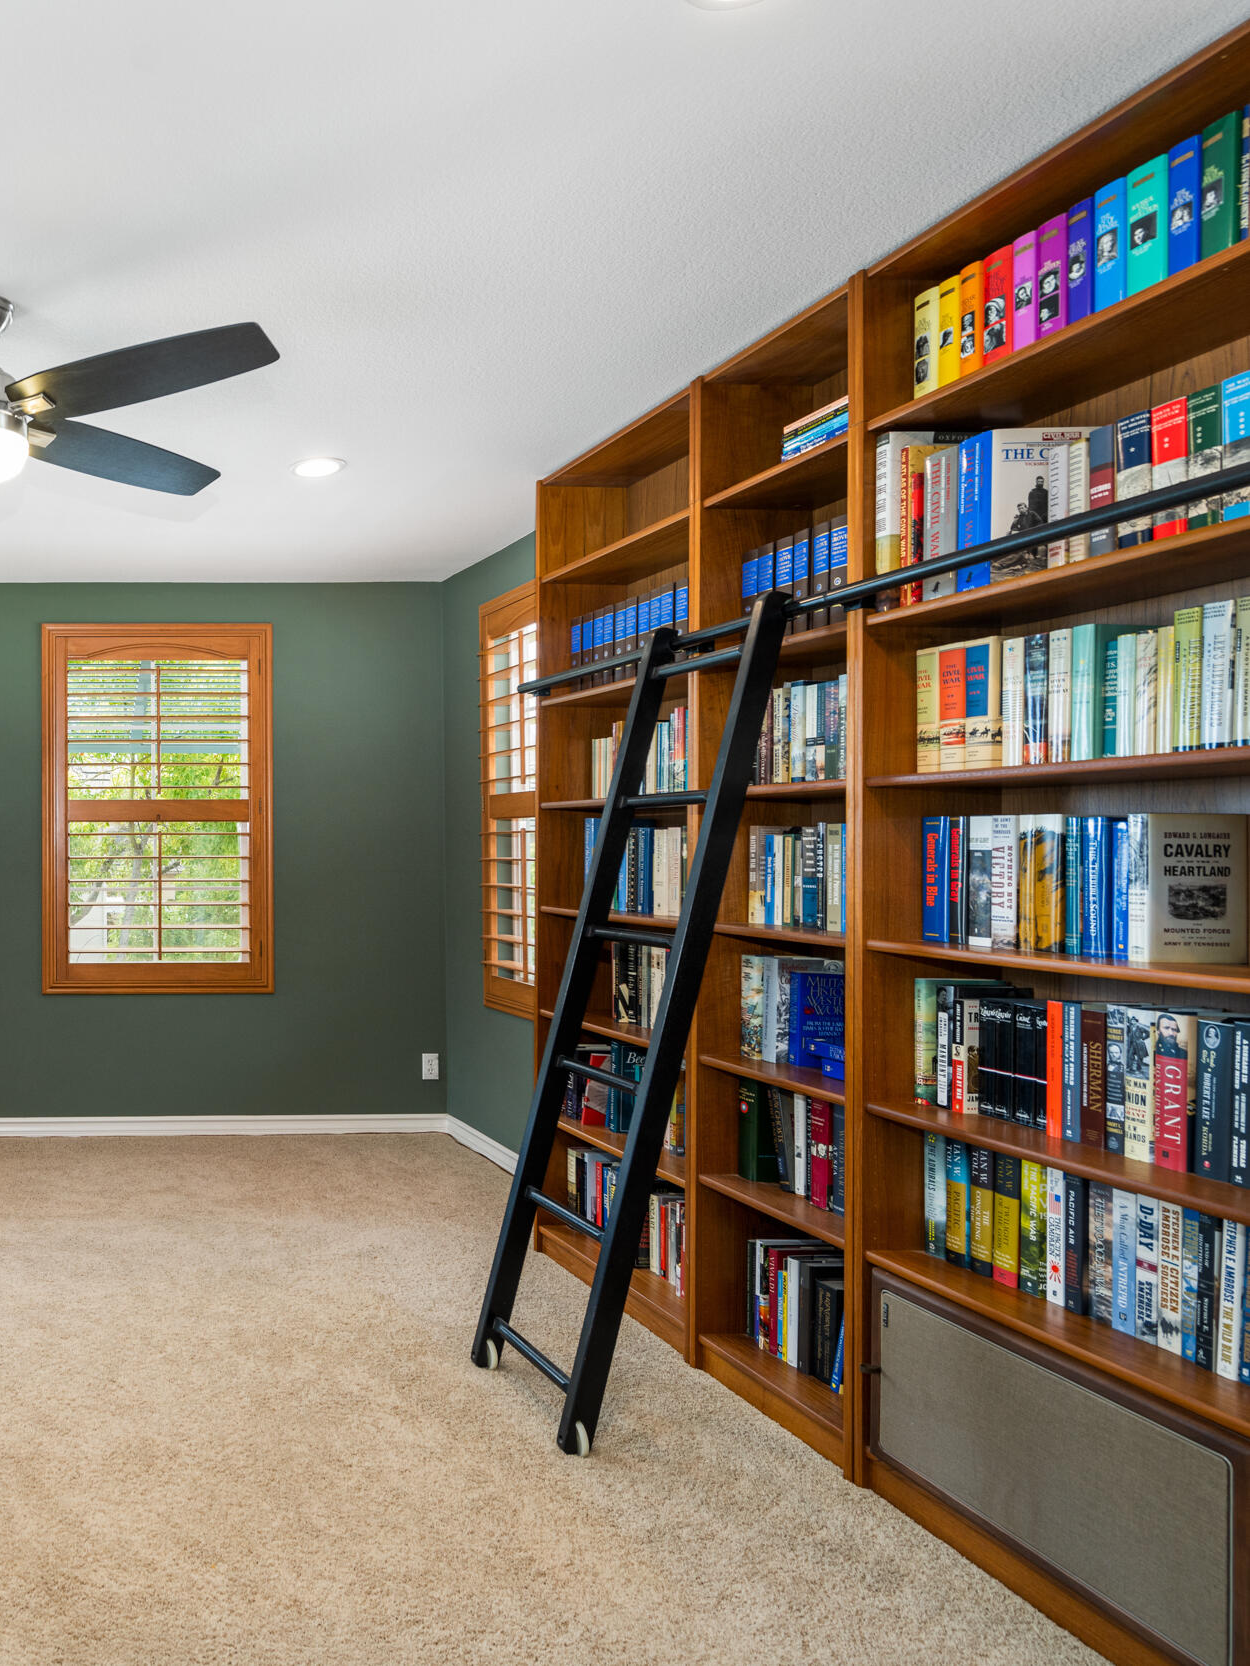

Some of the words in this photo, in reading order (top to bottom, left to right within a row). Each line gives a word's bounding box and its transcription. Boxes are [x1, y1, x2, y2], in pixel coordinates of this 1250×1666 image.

[1002, 448, 1034, 460] THE
[931, 459, 941, 488] THE
[901, 489, 908, 499] OF
[965, 479, 974, 513] CIVIL
[931, 491, 941, 528] CIVIL
[1212, 633, 1226, 660] LEE'S
[943, 669, 960, 677] CIVIL
[943, 677, 961, 686] WAR
[1210, 663, 1225, 728] LIEUTENANTS
[1164, 831, 1190, 839] EDWARD
[925, 833, 939, 872] Generals
[951, 828, 962, 867] Generals
[1163, 843, 1231, 858] CAVALRY
[925, 874, 939, 884] in
[951, 869, 962, 879] in
[992, 846, 1005, 909] VICTORY
[1163, 865, 1231, 877] HEARTLAND
[925, 885, 939, 907] Blue
[950, 881, 962, 904] Gray
[1089, 903, 1098, 937] SOUND
[939, 1043, 948, 1078] MANHUNT
[1089, 1041, 1103, 1113] SHERMAN
[1134, 1082, 1147, 1092] MAN
[1202, 1073, 1211, 1098] ROBERT
[1164, 1065, 1181, 1145] GRANT
[1202, 1106, 1211, 1121] LEE
[833, 1145, 838, 1156] AT
[928, 1144, 937, 1157] THE
[1201, 1126, 1209, 1156] KORDA
[953, 1144, 961, 1162] IAN
[980, 1150, 988, 1171] IAN
[928, 1158, 937, 1192] ADMIRALS
[953, 1165, 961, 1177] W.
[980, 1172, 988, 1184] W.
[1005, 1159, 1014, 1177] IAN
[838, 1188, 845, 1197] II
[1005, 1179, 1014, 1191] W.
[953, 1191, 961, 1229] PACIFIC
[1030, 1183, 1038, 1217] PACIFIC
[1029, 1220, 1038, 1242] WAR
[1139, 1204, 1154, 1251] D-DAY
[1161, 1206, 1171, 1258] AMBROSE
[1172, 1209, 1180, 1254] STEPHEN
[1224, 1220, 1238, 1256] STEPHEN
[1119, 1232, 1129, 1260] Called
[1172, 1254, 1180, 1262] E.
[1117, 1260, 1128, 1308] INTREPID
[1160, 1264, 1169, 1310] SOLDIERS
[1170, 1267, 1180, 1315] CITIZEN
[1223, 1264, 1237, 1305] AMBROSE
[1223, 1305, 1234, 1322] THE
[1222, 1322, 1233, 1343] WILD
[1222, 1343, 1232, 1365] BLUE
